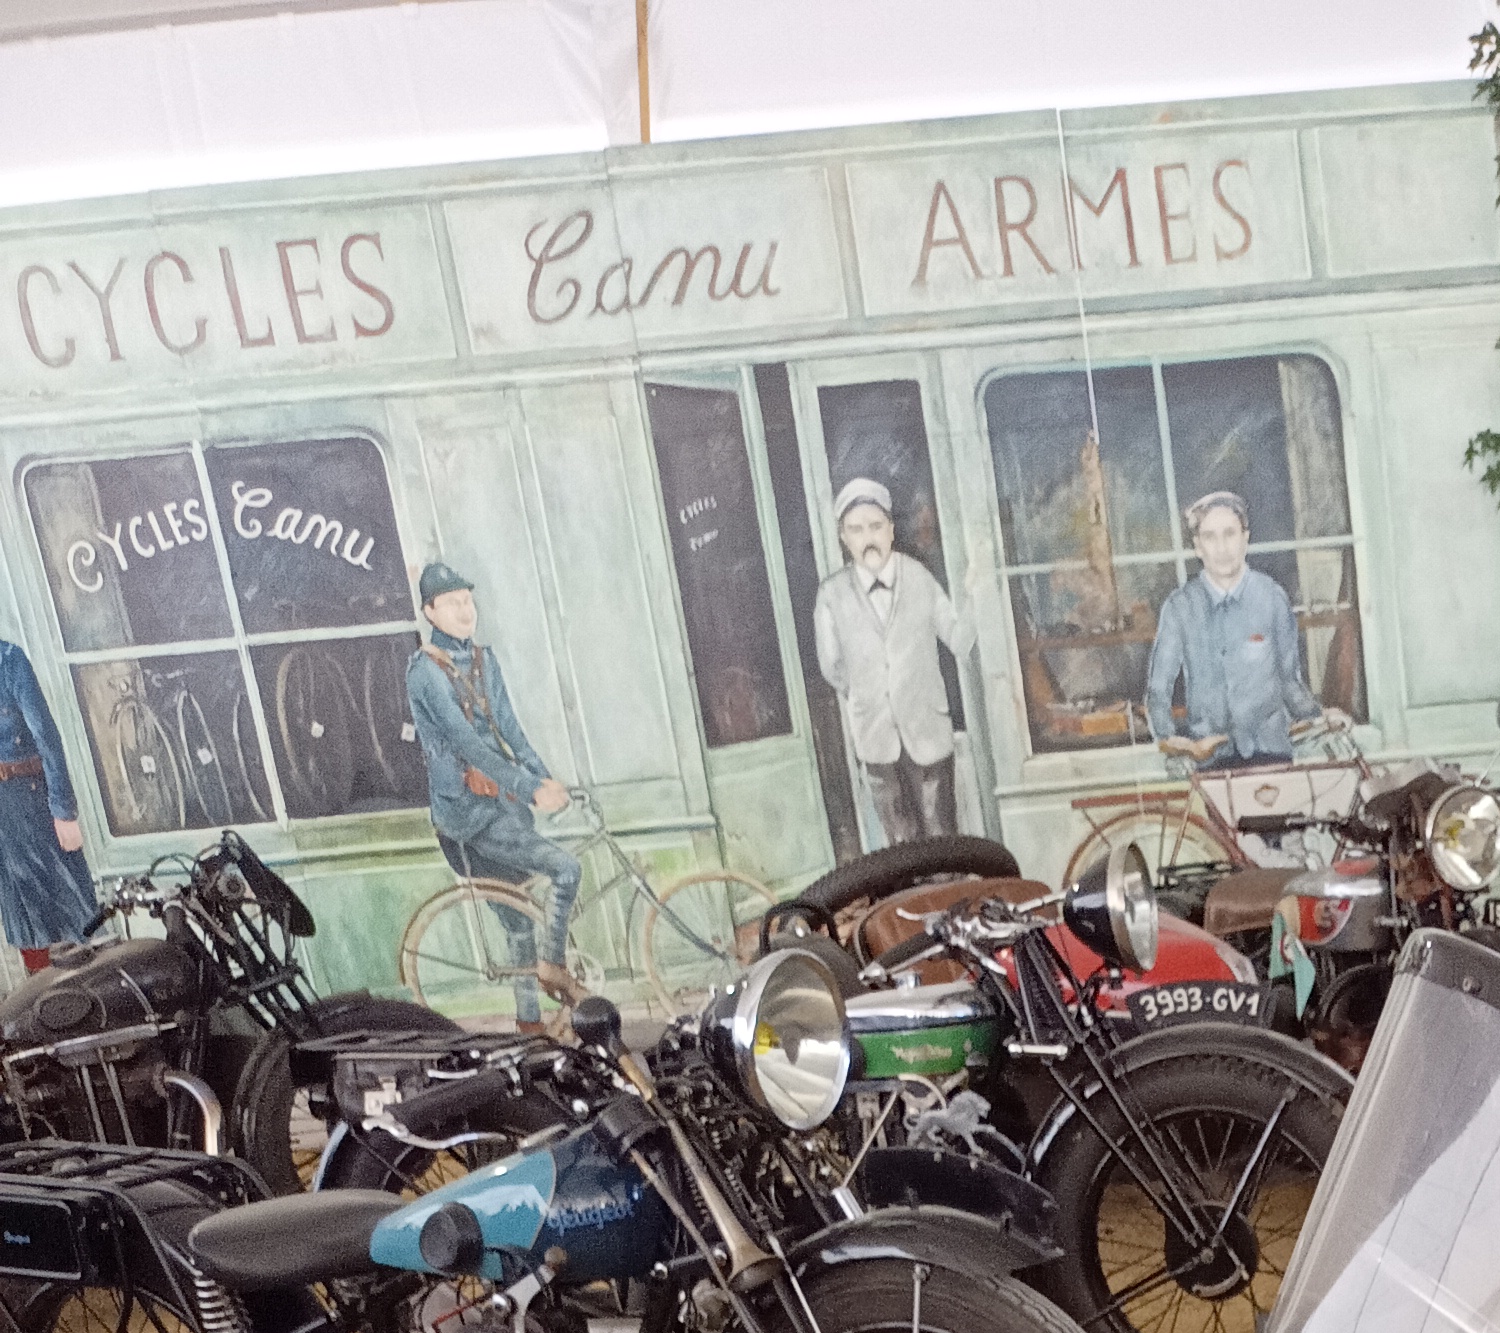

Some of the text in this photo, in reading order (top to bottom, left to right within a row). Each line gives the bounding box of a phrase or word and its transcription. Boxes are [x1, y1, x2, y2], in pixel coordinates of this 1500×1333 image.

[16, 159, 1254, 369] CYCLES Canu ARMES
[67, 480, 375, 593] CYCLES Canu
